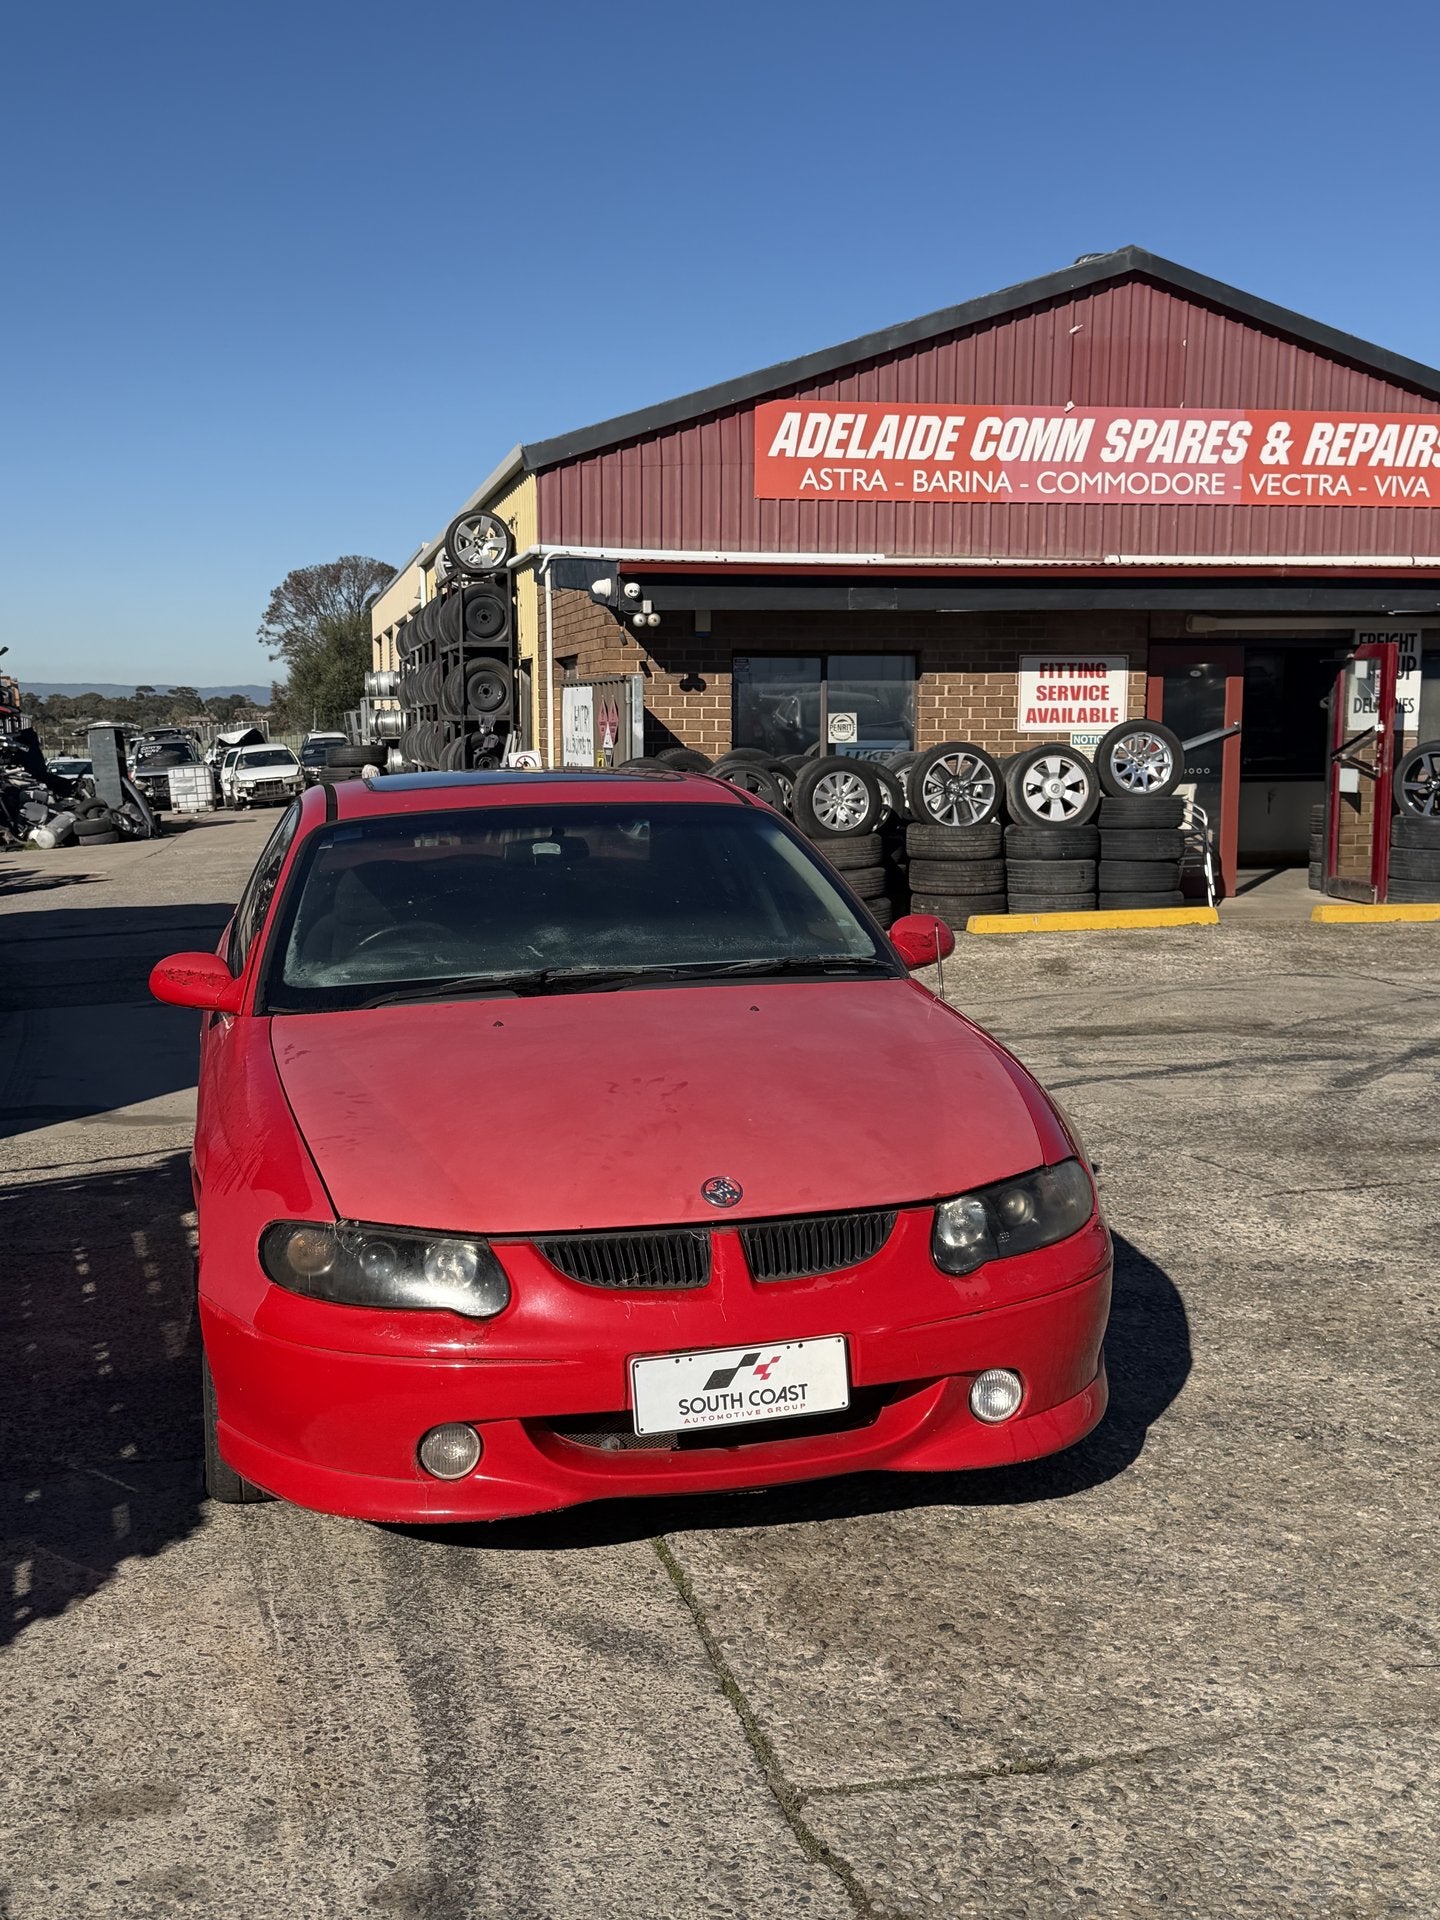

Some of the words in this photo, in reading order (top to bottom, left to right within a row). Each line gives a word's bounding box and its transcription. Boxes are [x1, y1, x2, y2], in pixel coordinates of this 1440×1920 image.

[767, 411, 966, 461] ADELAIDE
[969, 415, 1096, 463] COMM
[1100, 418, 1253, 465] SPARES
[1259, 421, 1294, 466] &
[1301, 422, 1440, 468] REPAIR
[799, 467, 888, 492] ASTRA
[913, 470, 1013, 494] BARINA
[1036, 471, 1226, 495] COMMODORE
[1249, 473, 1352, 497] VECTRA
[1374, 475, 1431, 498] VIVA
[1039, 662, 1107, 678] FITTING
[1036, 685, 1110, 701] SERVICE
[1025, 707, 1119, 723] AVAILABLE
[829, 723, 856, 732] PENRITE
[1073, 735, 1104, 744] NOTIC
[678, 1391, 744, 1416] SOUTH
[748, 1383, 808, 1406] COAST
[683, 1408, 762, 1424] AUTOMOTIVE
[767, 1402, 807, 1414] GROUP
